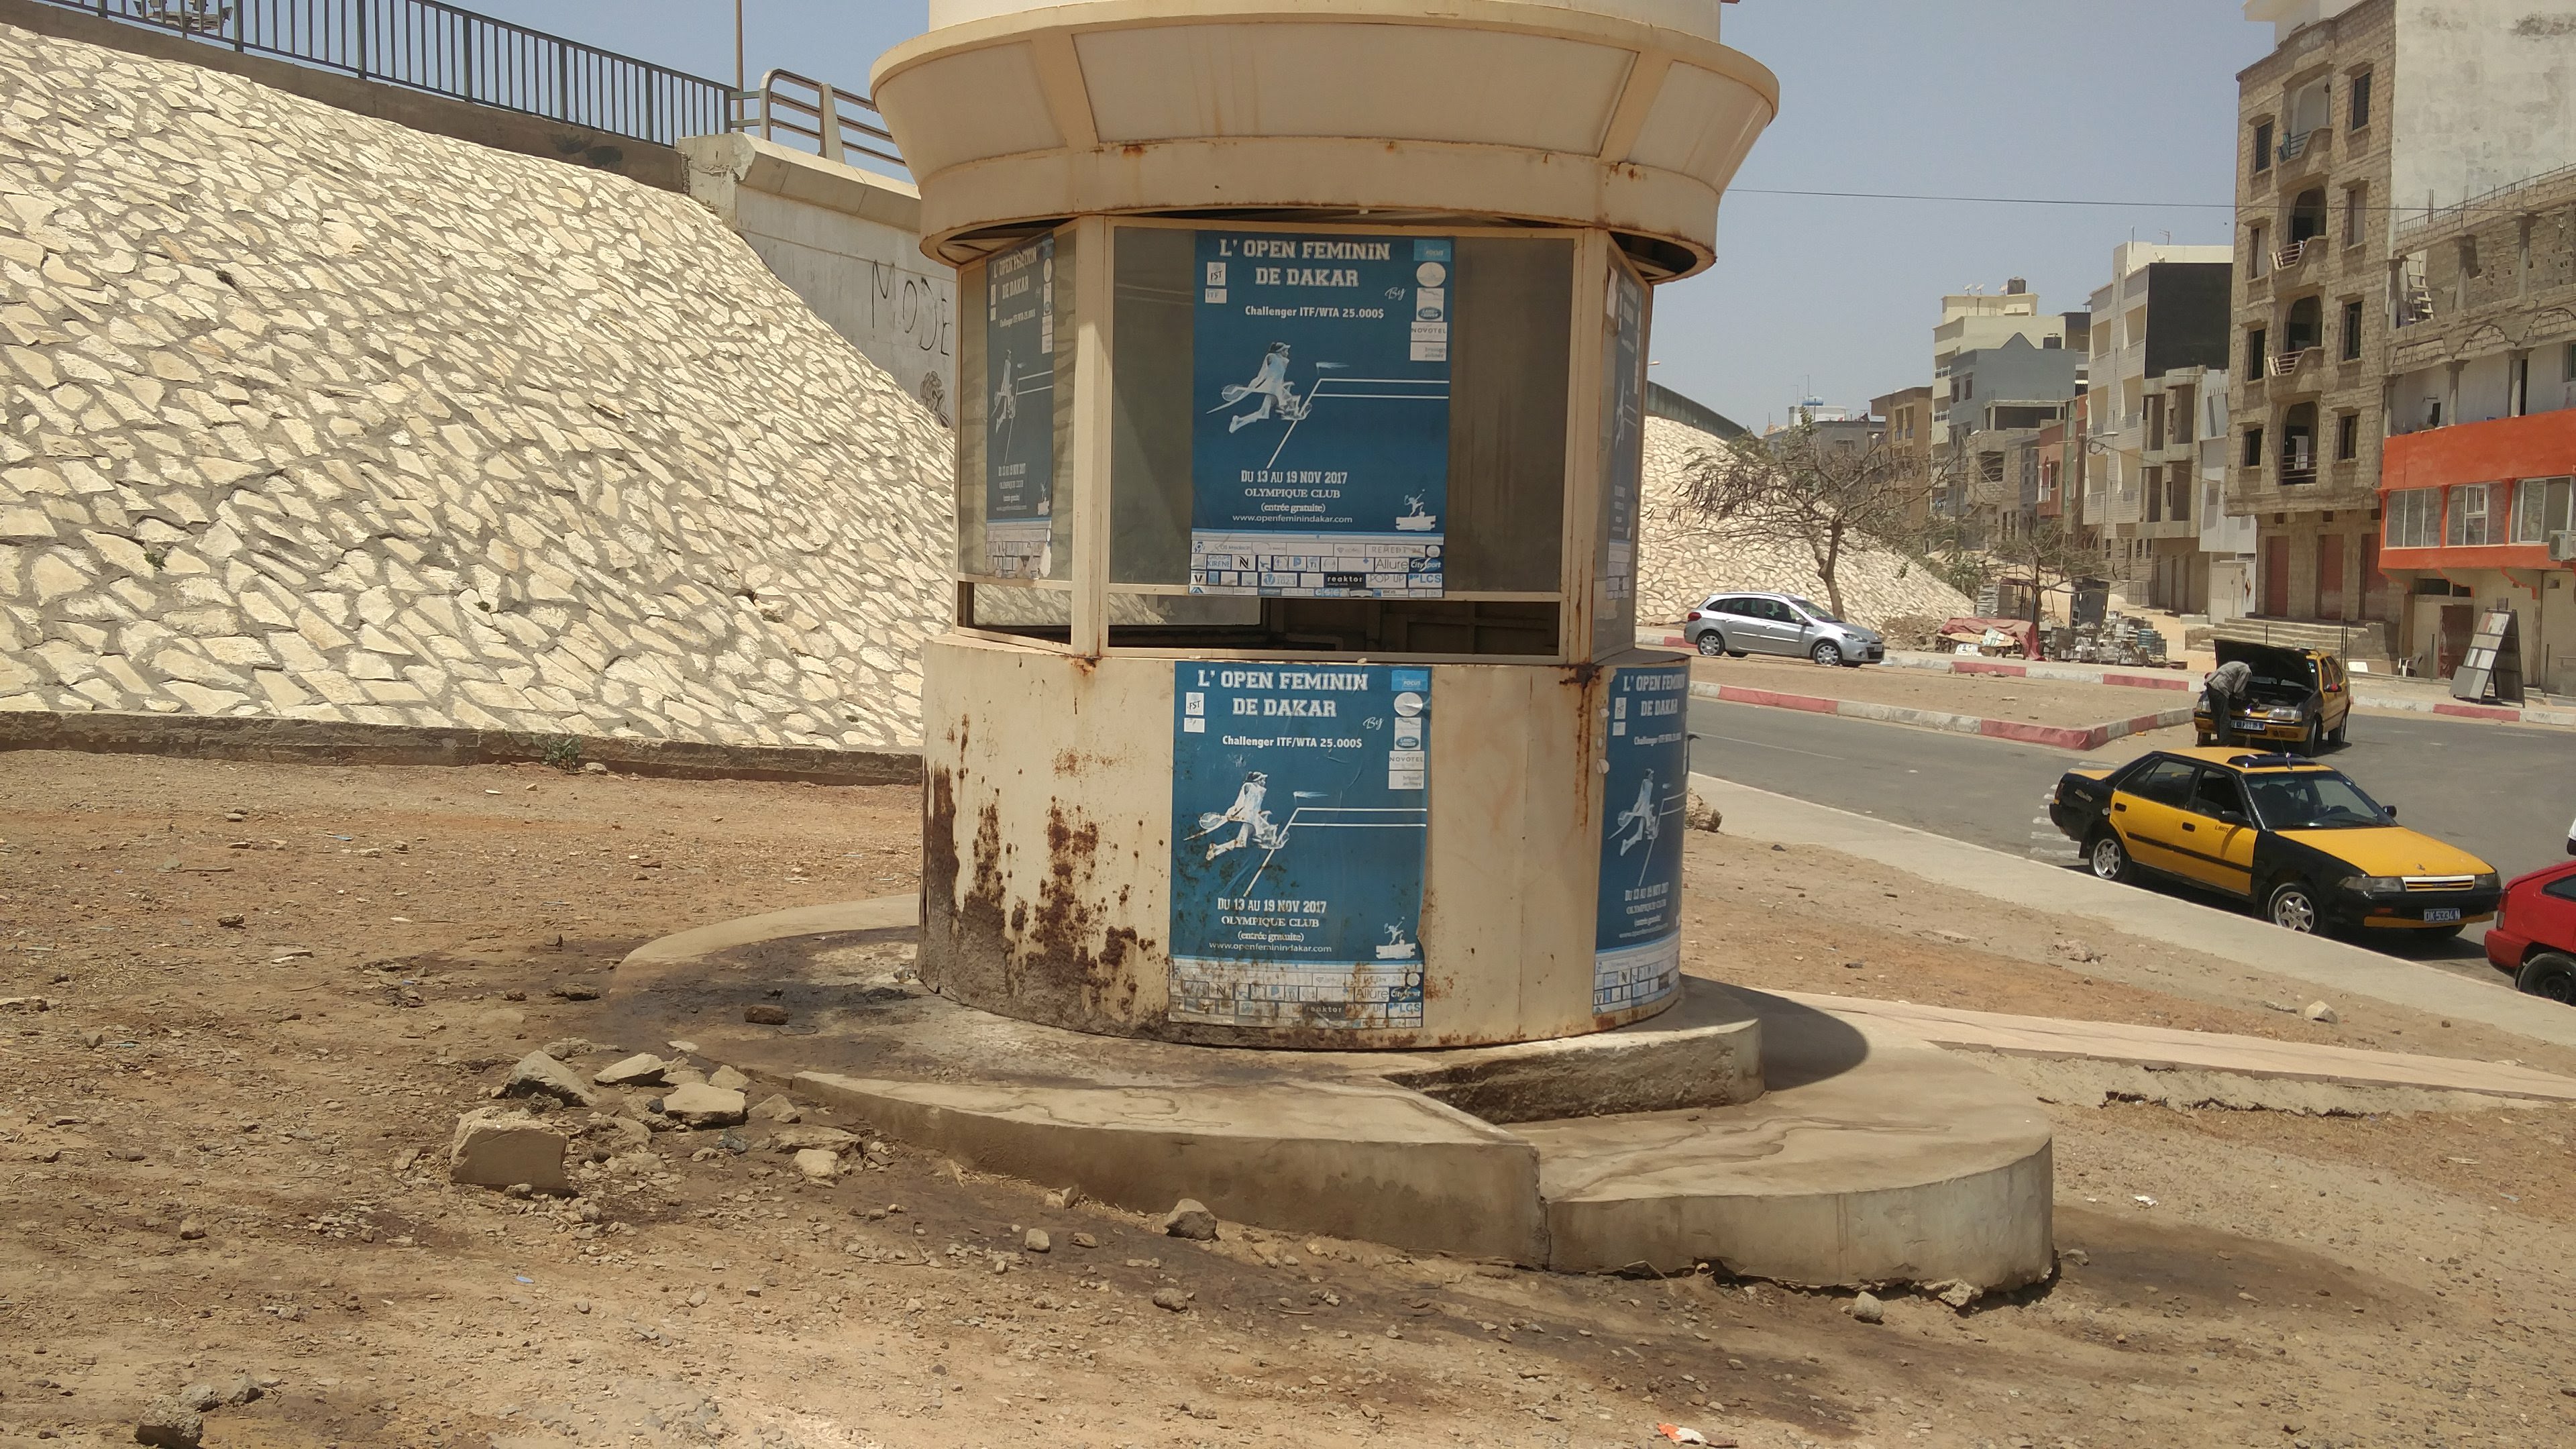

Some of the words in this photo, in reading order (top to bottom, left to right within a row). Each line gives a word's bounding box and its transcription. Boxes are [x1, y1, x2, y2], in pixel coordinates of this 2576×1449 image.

[1243, 239, 1296, 259] OPEN
[1301, 241, 1391, 260] FEMININ
[1255, 267, 1281, 285] DE
[1286, 268, 1360, 287] DAKAR
[1385, 286, 1405, 301] By
[1245, 306, 1296, 319] Challenger
[1299, 307, 1339, 318] ITF/WTA
[1342, 308, 1384, 319] 25.000$
[1241, 470, 1254, 482] DU
[1257, 470, 1268, 482] 13
[1271, 472, 1283, 483] AU
[1287, 471, 1297, 483] 19
[1299, 472, 1322, 484] NOV
[1324, 472, 1348, 484] 2017
[1244, 488, 1307, 498] OLYMPIQUE
[1311, 489, 1340, 498] CLUB
[1232, 514, 1352, 523] www.openfeminindakar.com
[1375, 559, 1409, 570] Allure
[1393, 575, 1405, 583] UP
[1419, 575, 1442, 583] LCS
[1198, 670, 1215, 687] L'
[1220, 671, 1273, 689] OPEN
[1279, 673, 1368, 691] FEMININ
[1636, 675, 1660, 691] OPEN
[1232, 698, 1258, 715] DE
[1263, 699, 1338, 717] DAKAR
[1641, 700, 1652, 716] DE
[1362, 717, 1383, 731] By
[1222, 735, 1275, 748] Challenger
[1277, 737, 1317, 747] ITF/WTA
[1320, 738, 1362, 748] 25.000$
[1218, 898, 1230, 910] DU
[1234, 898, 1244, 910] 13
[1248, 900, 1260, 912] AU
[1264, 900, 1275, 912] 19
[1277, 900, 1300, 912] NOV
[1303, 901, 1327, 914] 2017
[1221, 916, 1286, 927] OLYMPIQUE
[1289, 918, 1320, 927] CLUB
